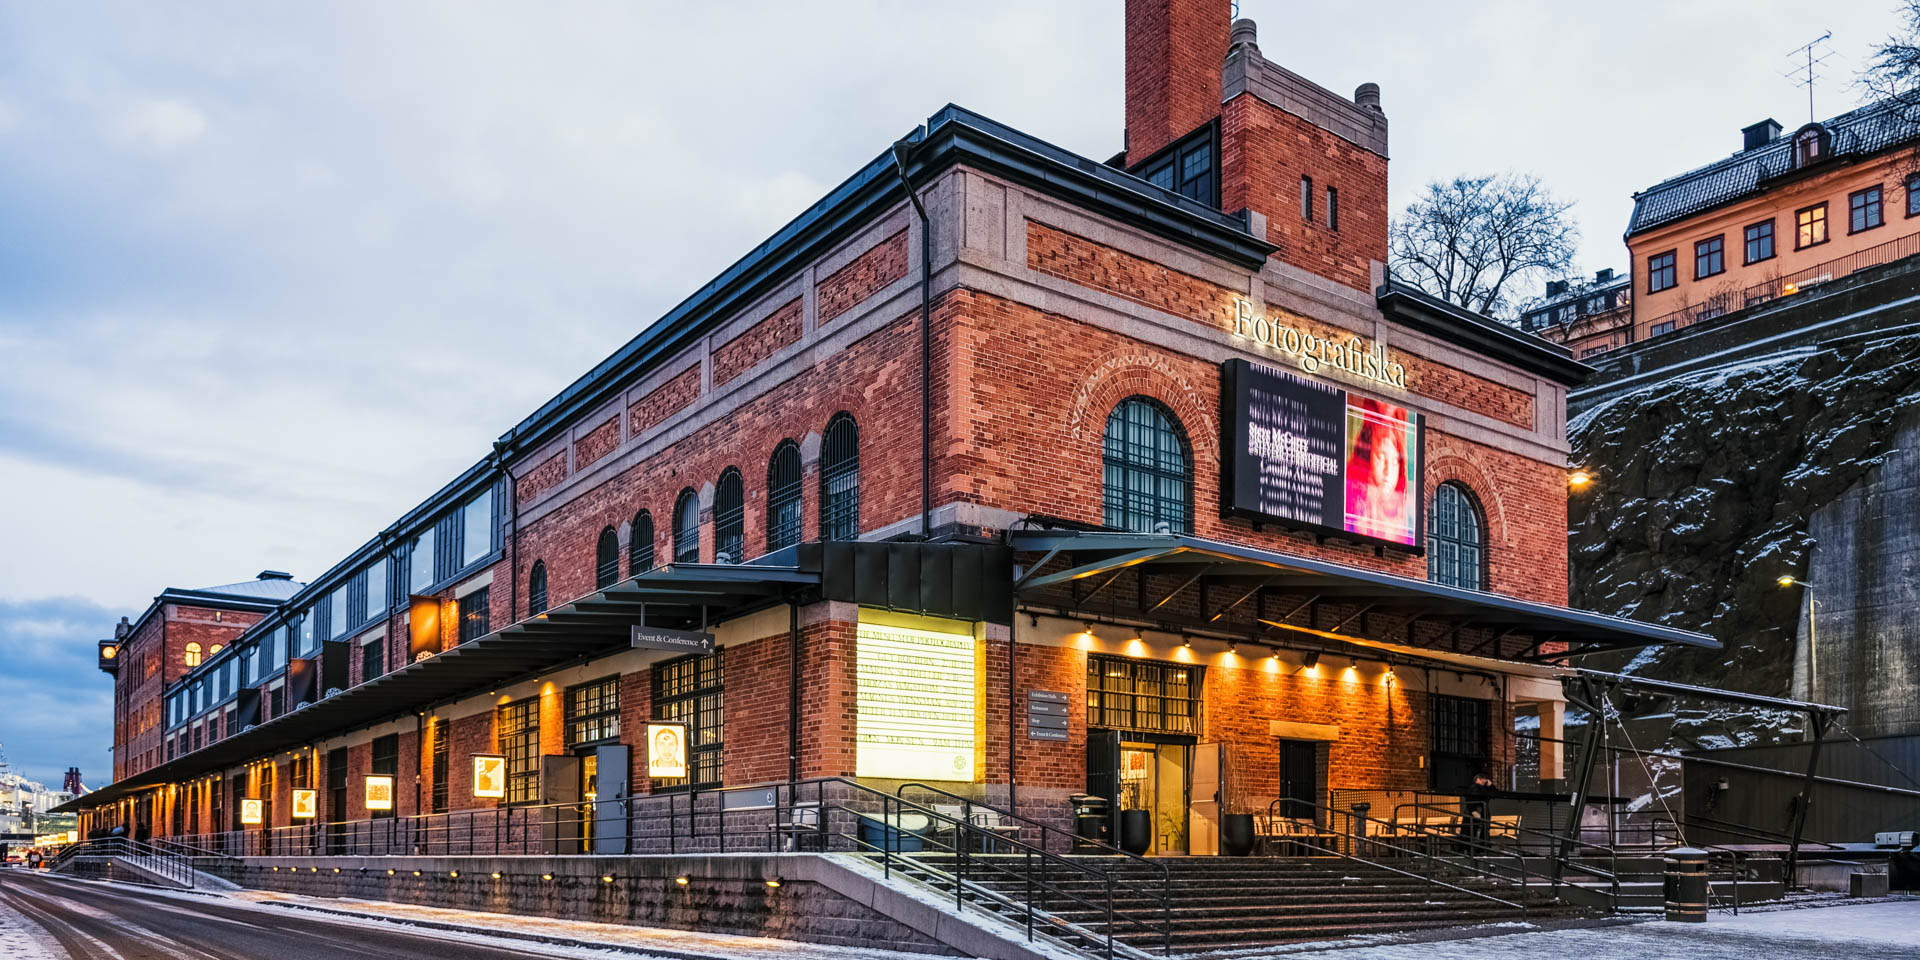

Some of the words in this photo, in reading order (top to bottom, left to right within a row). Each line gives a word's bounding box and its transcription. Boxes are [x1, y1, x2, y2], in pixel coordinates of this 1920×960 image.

[1233, 297, 1406, 389] Fotografiska
[637, 632, 656, 642] Event
[656, 635, 663, 643] &
[663, 635, 699, 647] Conference
[1183, 717, 1193, 733] A
